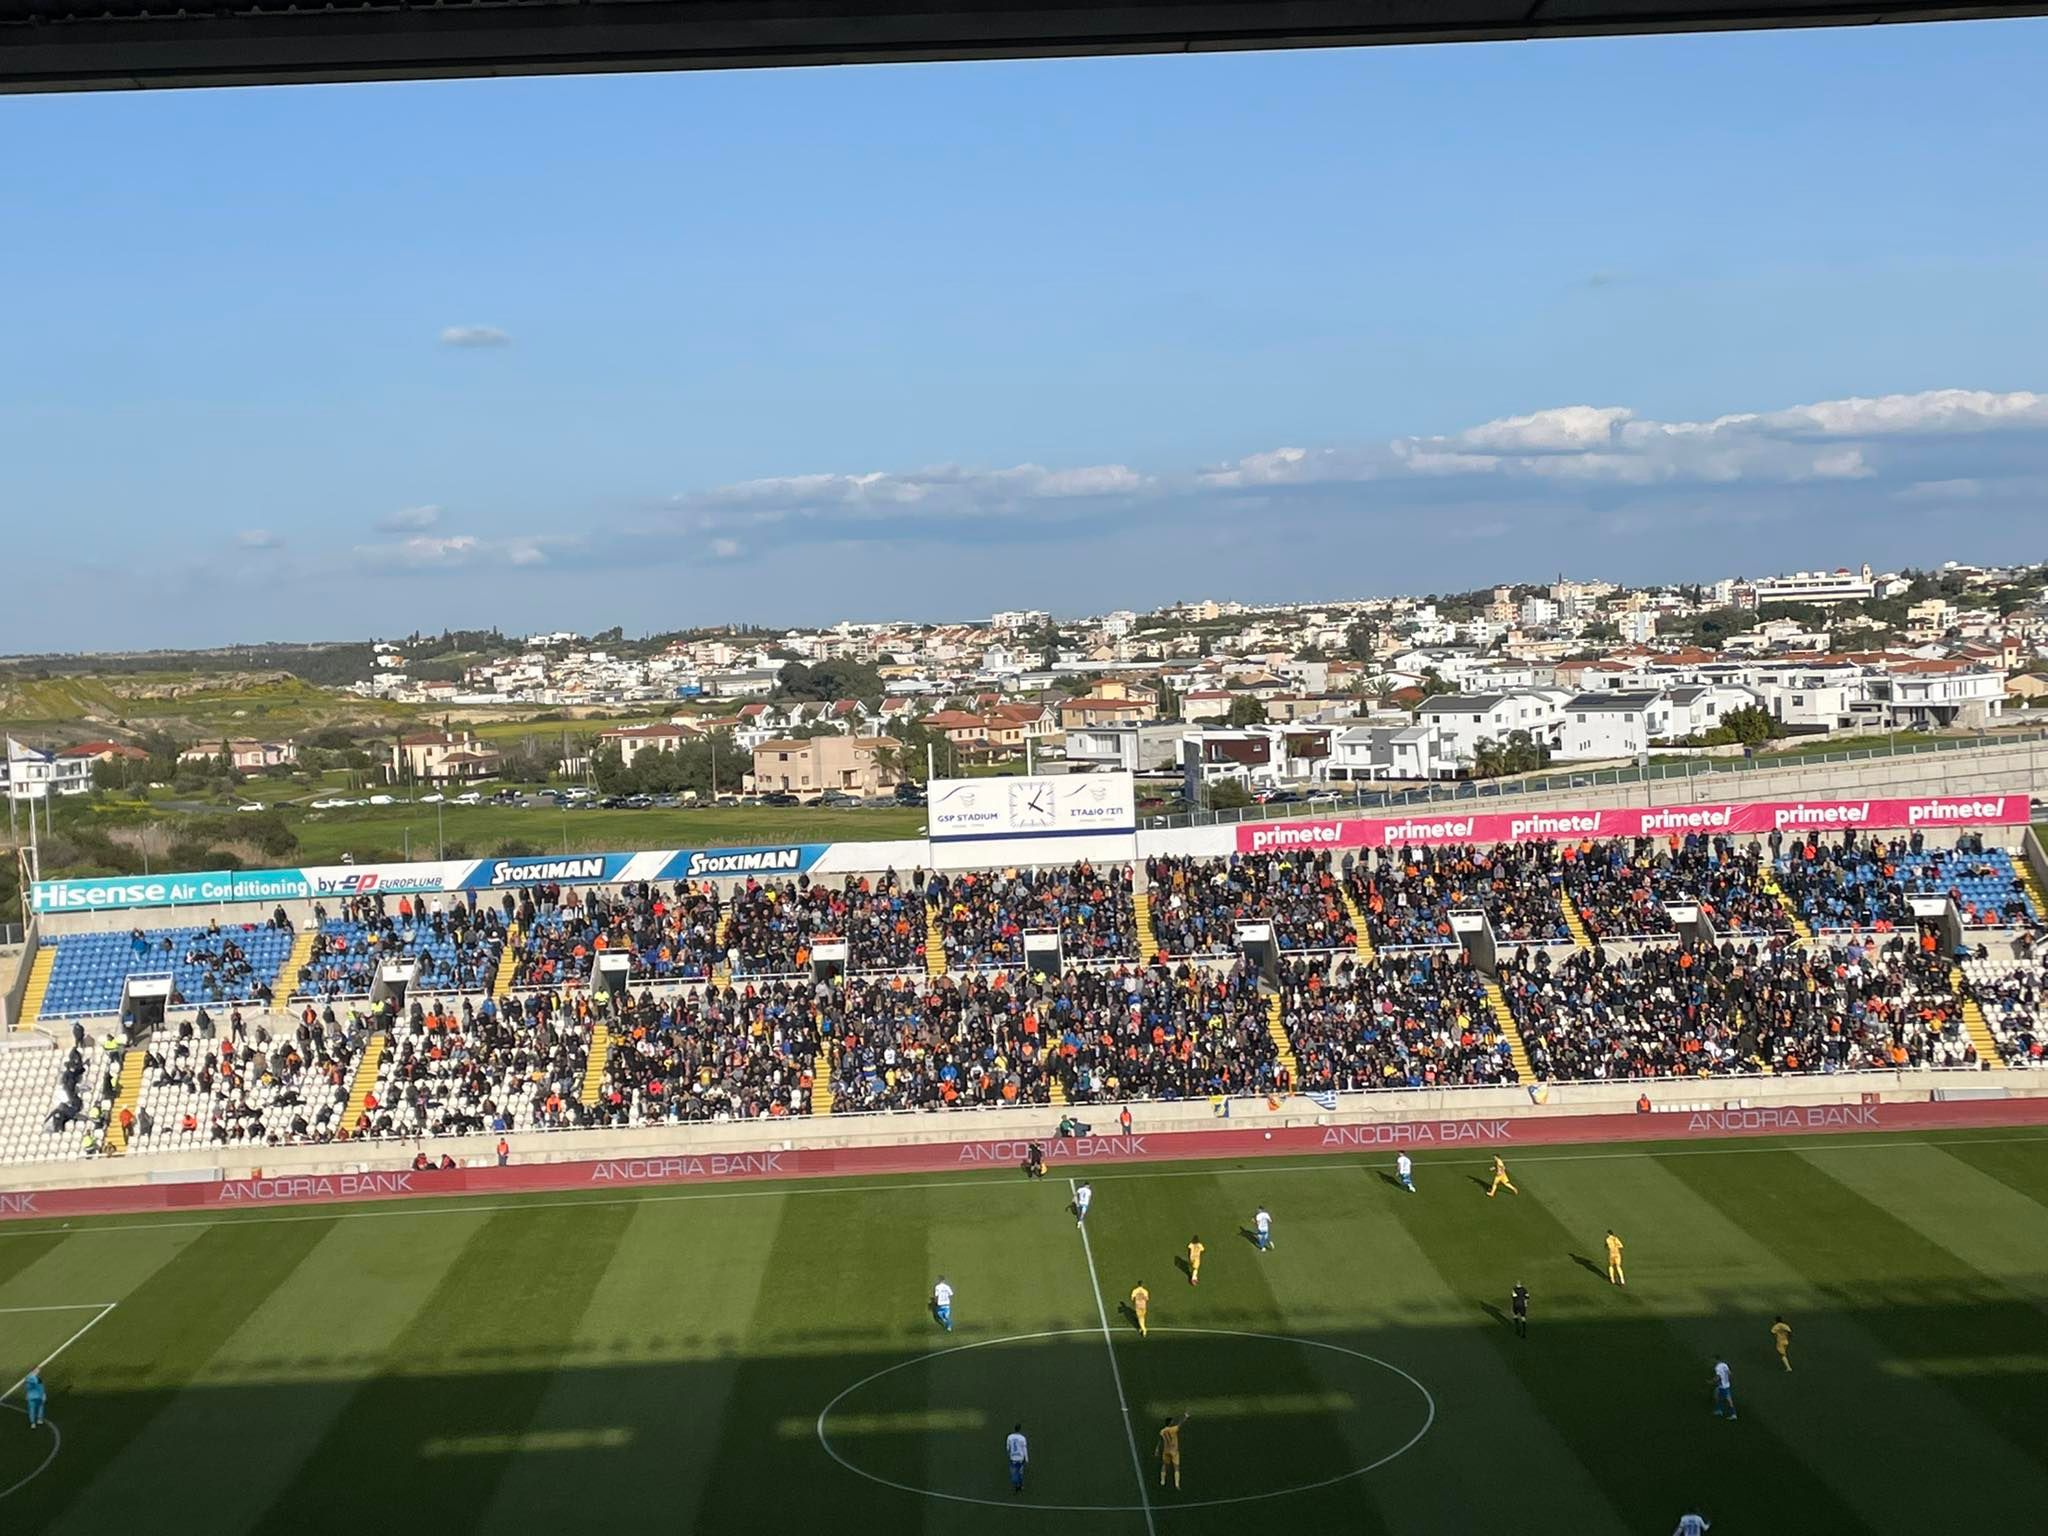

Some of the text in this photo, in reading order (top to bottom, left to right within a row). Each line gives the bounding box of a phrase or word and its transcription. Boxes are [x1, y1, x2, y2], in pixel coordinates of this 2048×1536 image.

[937, 812, 999, 823] GSP STADIUM
[1641, 806, 1732, 833] primetel
[1775, 802, 1870, 828] primetel
[1908, 798, 2005, 824] primetel
[1253, 822, 1342, 849] primetel
[1384, 817, 1475, 845] primetel
[1511, 811, 1601, 839] primetel
[491, 858, 604, 885] STOIXIMAN
[688, 850, 799, 876] STOIXIMAN
[33, 883, 165, 908] Hisense
[169, 883, 197, 900] Air
[201, 879, 307, 898] Conditioning
[318, 877, 337, 892] by
[379, 877, 443, 889] EUROPLUMB
[1688, 1106, 1880, 1131] ANCORIA BANK
[1322, 1120, 1511, 1145] ANCORIA BANK
[1076, 1136, 1148, 1157] BANK
[592, 1153, 784, 1181] ANCORIA BANK
[218, 1173, 414, 1200] ANCORIA BANK
